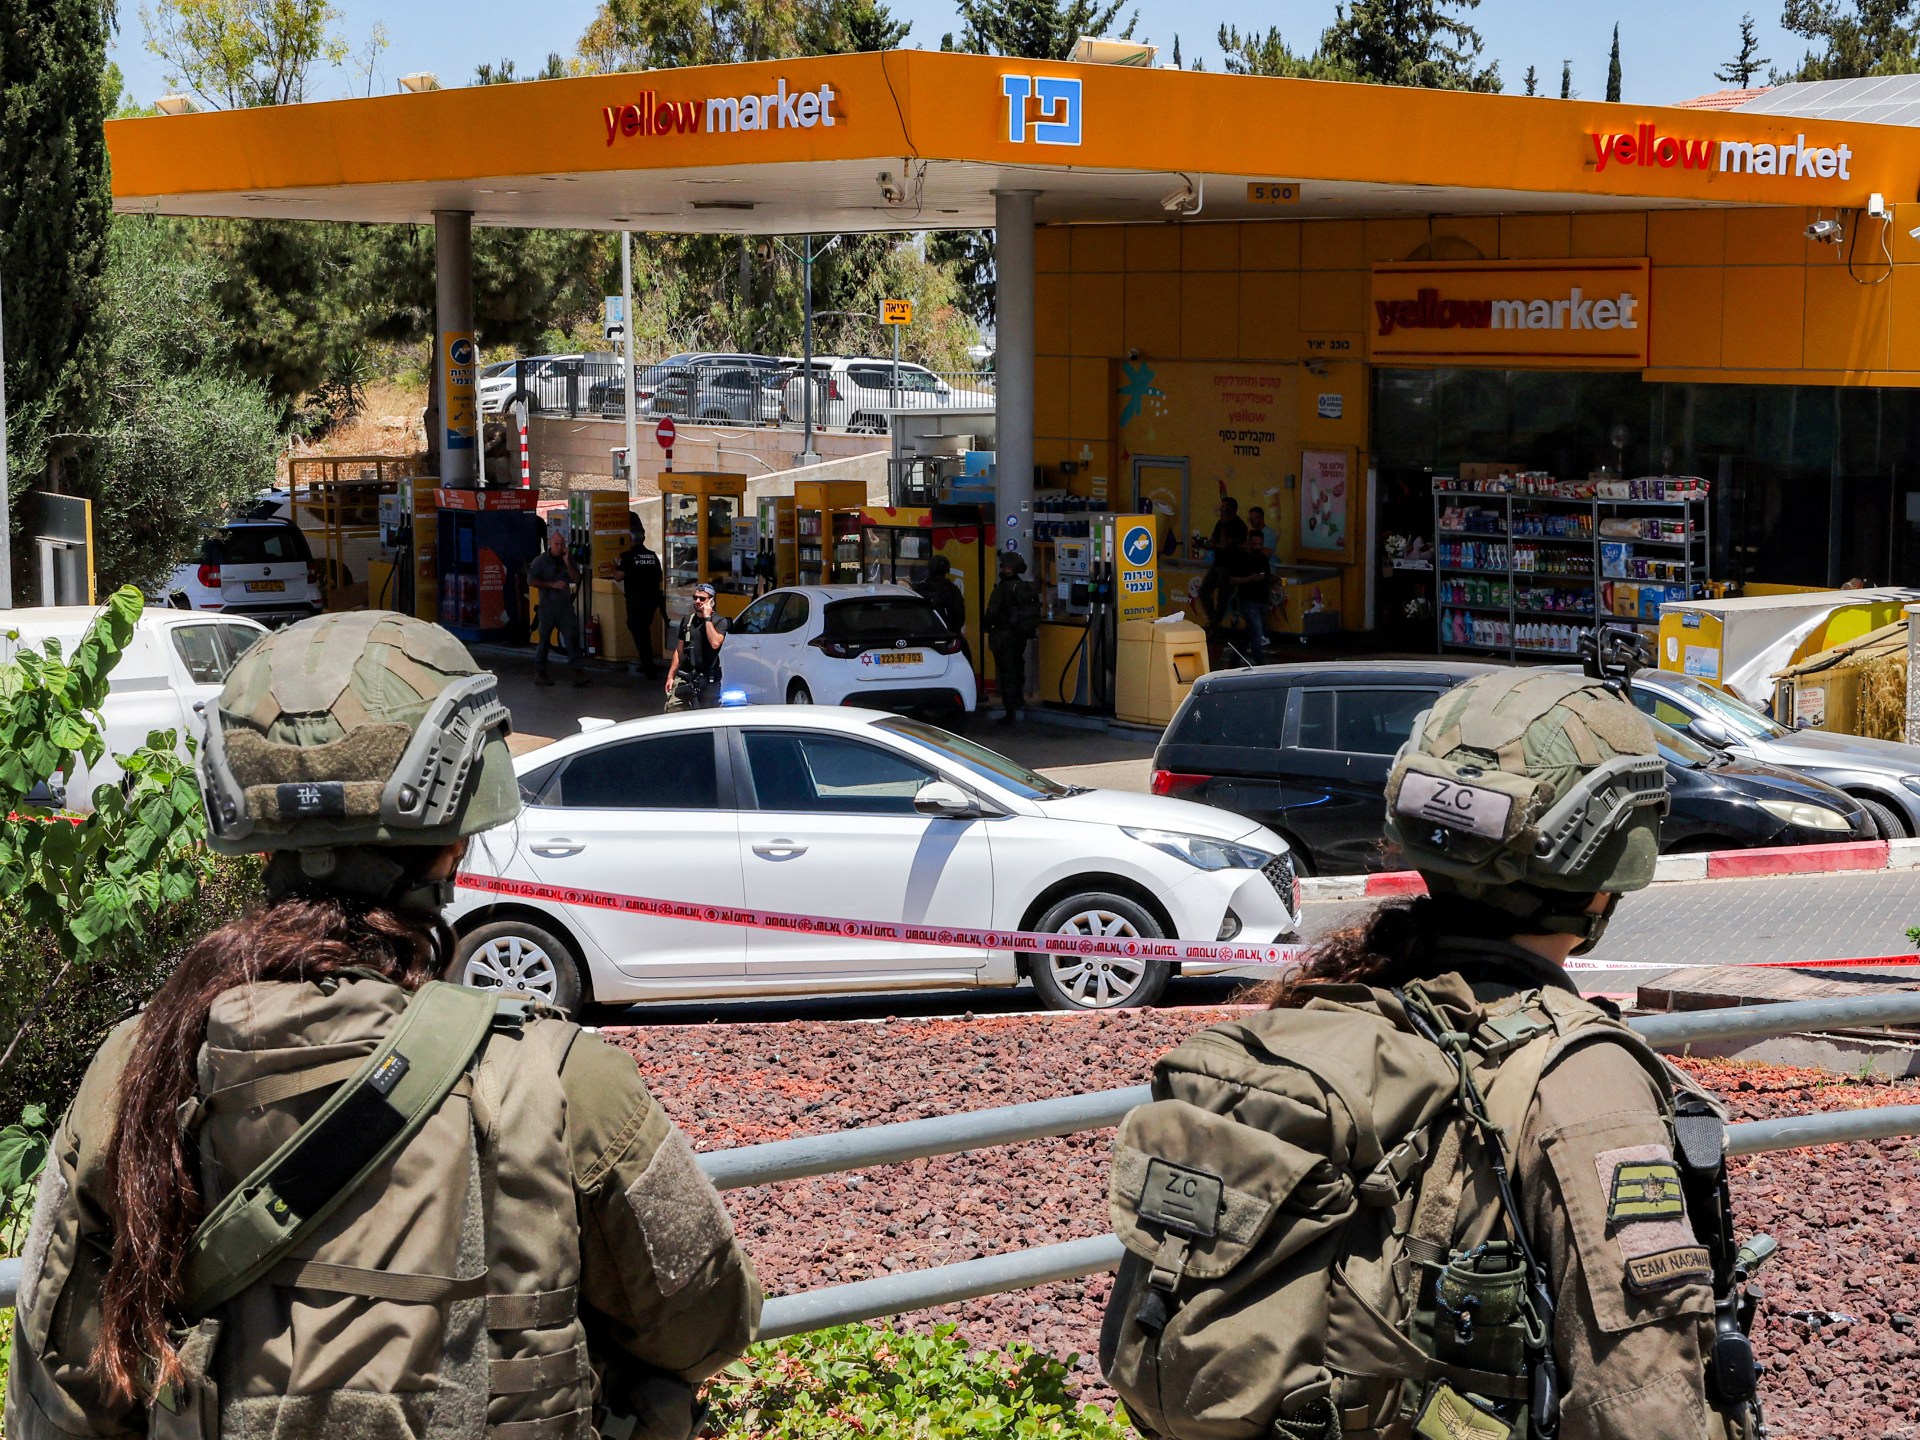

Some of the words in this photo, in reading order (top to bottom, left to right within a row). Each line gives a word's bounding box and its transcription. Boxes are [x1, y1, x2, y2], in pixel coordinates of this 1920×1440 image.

[885, 301, 909, 313] יציאה
[1307, 339, 1326, 350] יאיר
[1329, 339, 1350, 350] כוכב
[1228, 408, 1266, 424] yellow
[1219, 430, 1237, 442] כסף
[1238, 429, 1275, 444] ומקבלים
[1123, 570, 1154, 582] שירות
[1125, 581, 1154, 592] עצמי
[1124, 605, 1155, 615] לשירותכם
[765, 916, 797, 929] משטרת
[813, 921, 841, 935] ישראל
[873, 926, 898, 938] מעבר
[905, 929, 937, 941] משטרת
[953, 933, 981, 946] ישראל
[1014, 937, 1038, 949] מעבר
[1045, 939, 1077, 951] משטרת
[1094, 942, 1121, 956] ישראל
[1154, 944, 1178, 957] מעבר
[1186, 946, 1218, 958] משטרת
[1234, 949, 1262, 963] ישראל
[1632, 1259, 1667, 1280] TEAM
